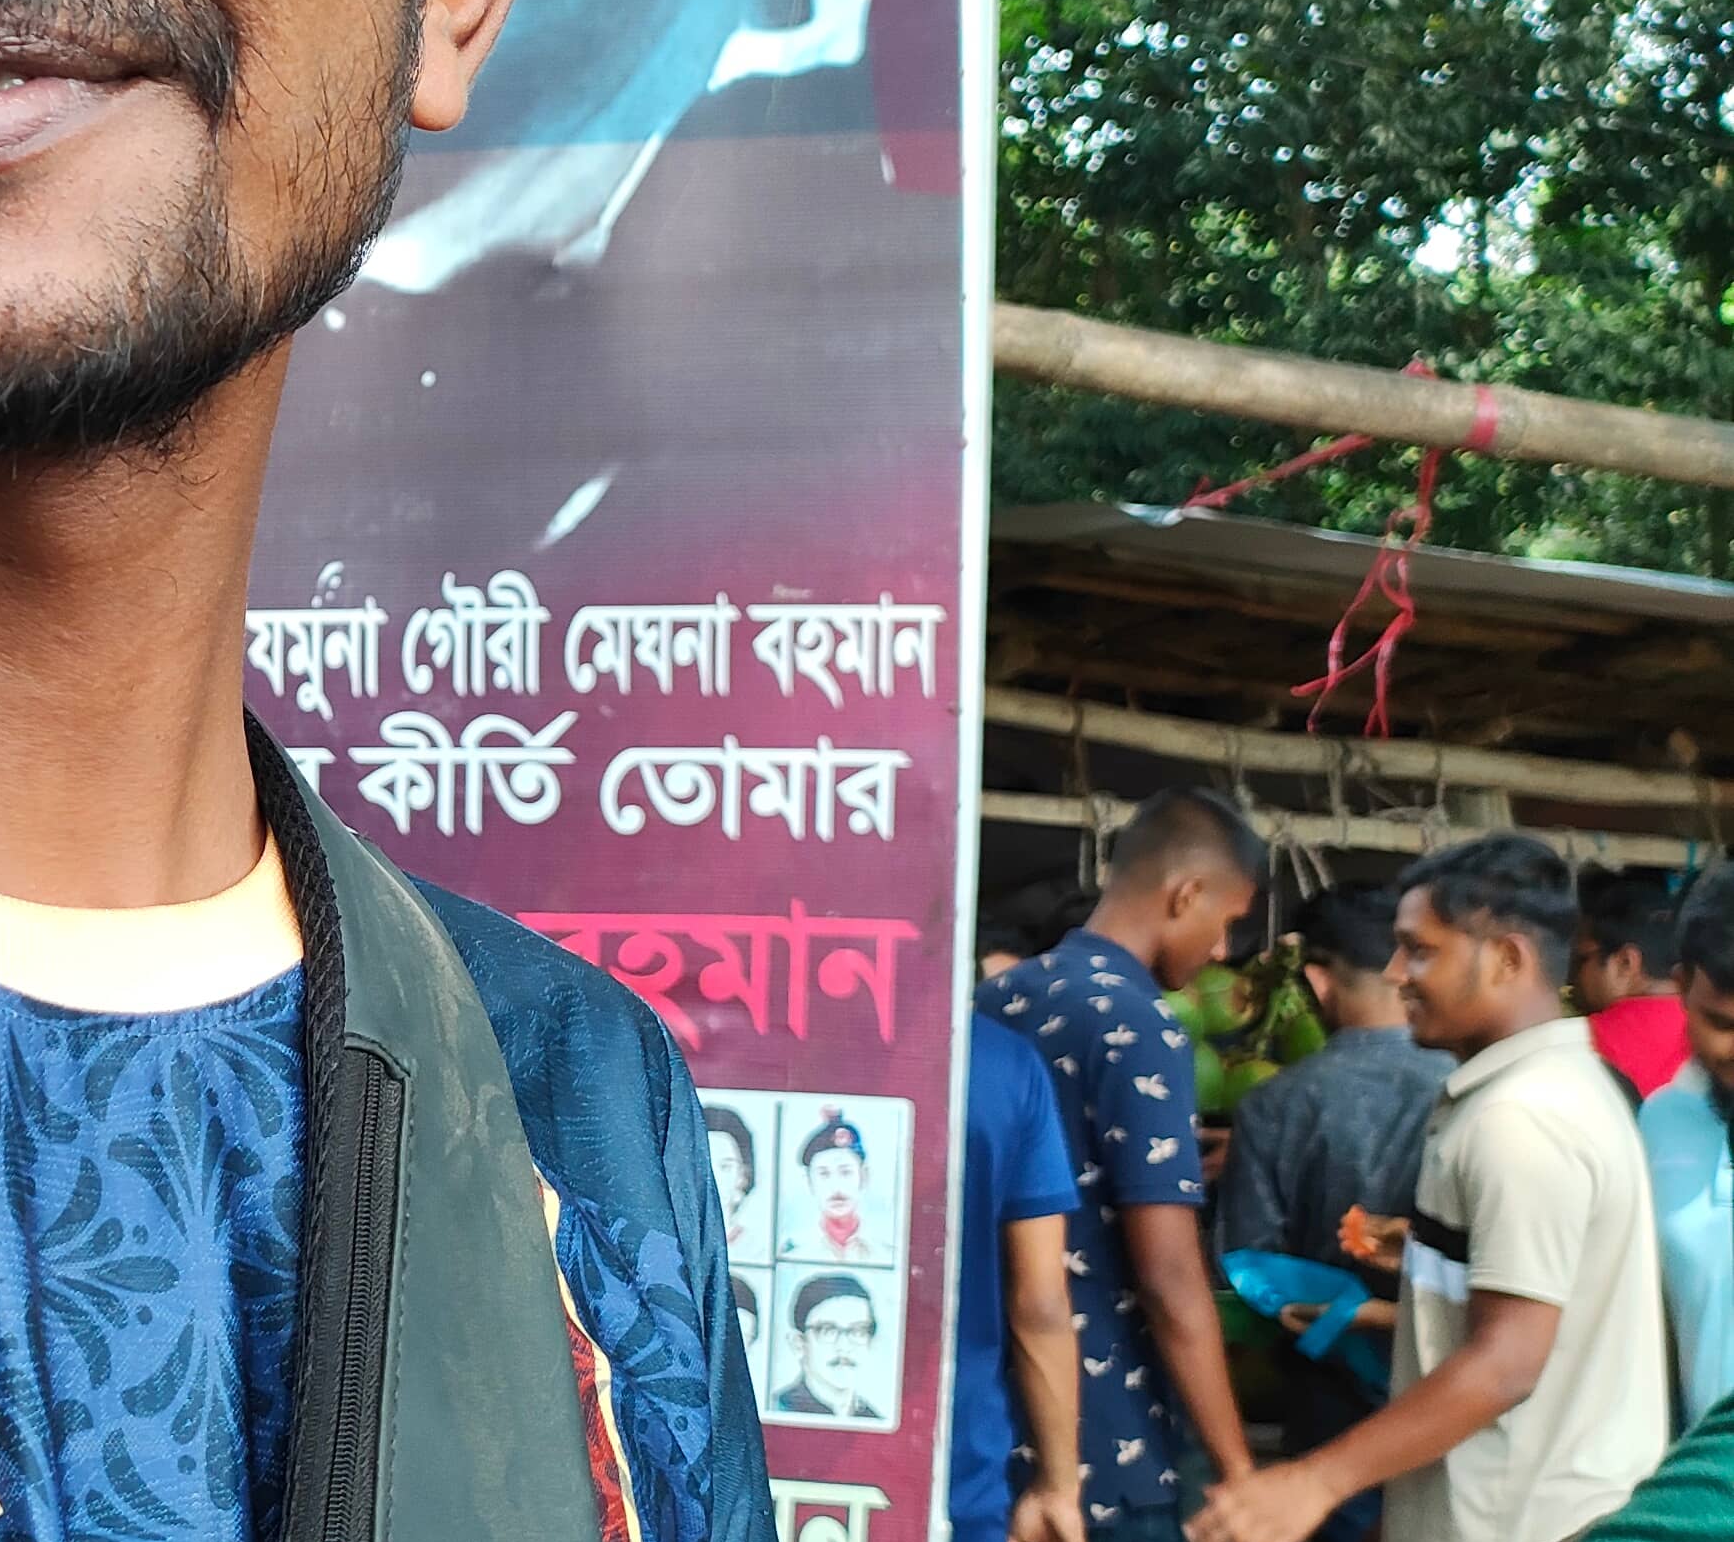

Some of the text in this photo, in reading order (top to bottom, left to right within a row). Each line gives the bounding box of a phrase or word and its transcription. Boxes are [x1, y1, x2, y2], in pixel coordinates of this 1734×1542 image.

[245, 570, 947, 721] যমুনা গৌরী মেঘনা বহমান
[347, 711, 578, 836] কীর্তি
[600, 734, 914, 842] তোমার
